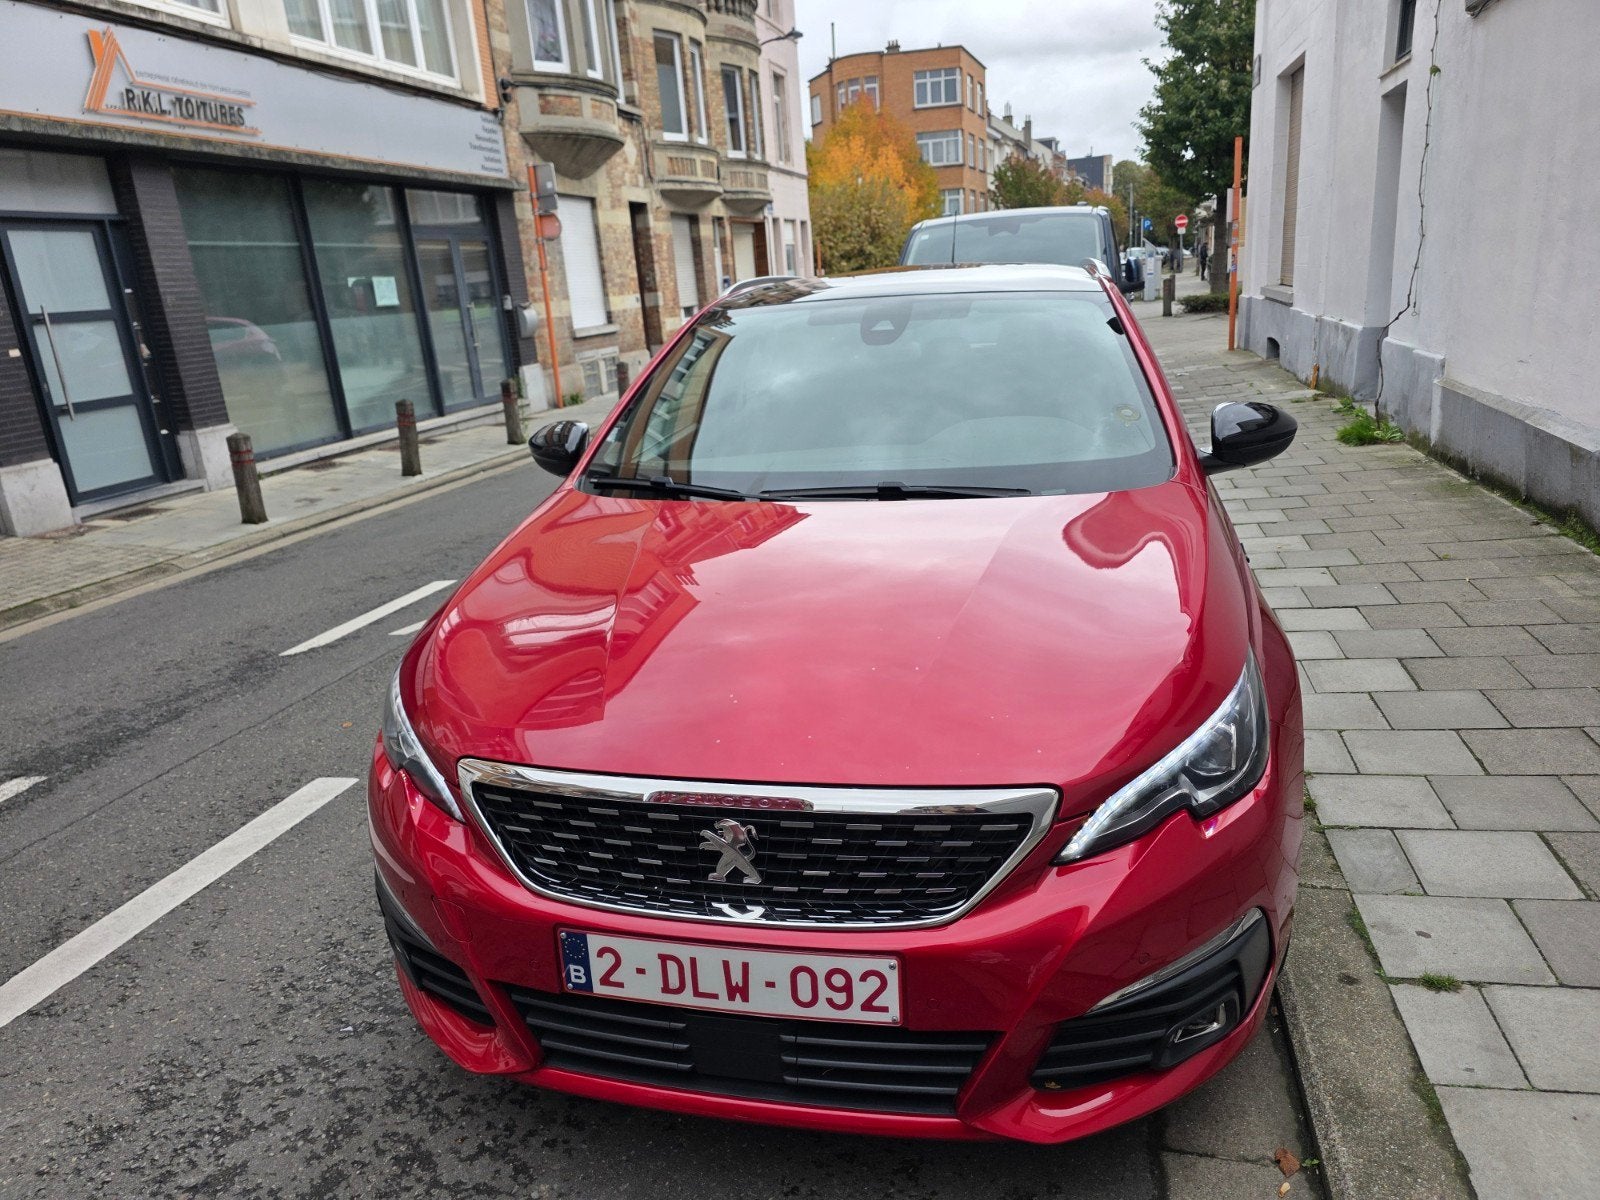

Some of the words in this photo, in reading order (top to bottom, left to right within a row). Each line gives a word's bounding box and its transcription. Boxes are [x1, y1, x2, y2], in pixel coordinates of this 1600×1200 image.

[124, 88, 171, 115] R.K.L.
[174, 97, 245, 126] TOITURES
[570, 965, 586, 984] B
[596, 946, 889, 1013] 2-DLW-092
